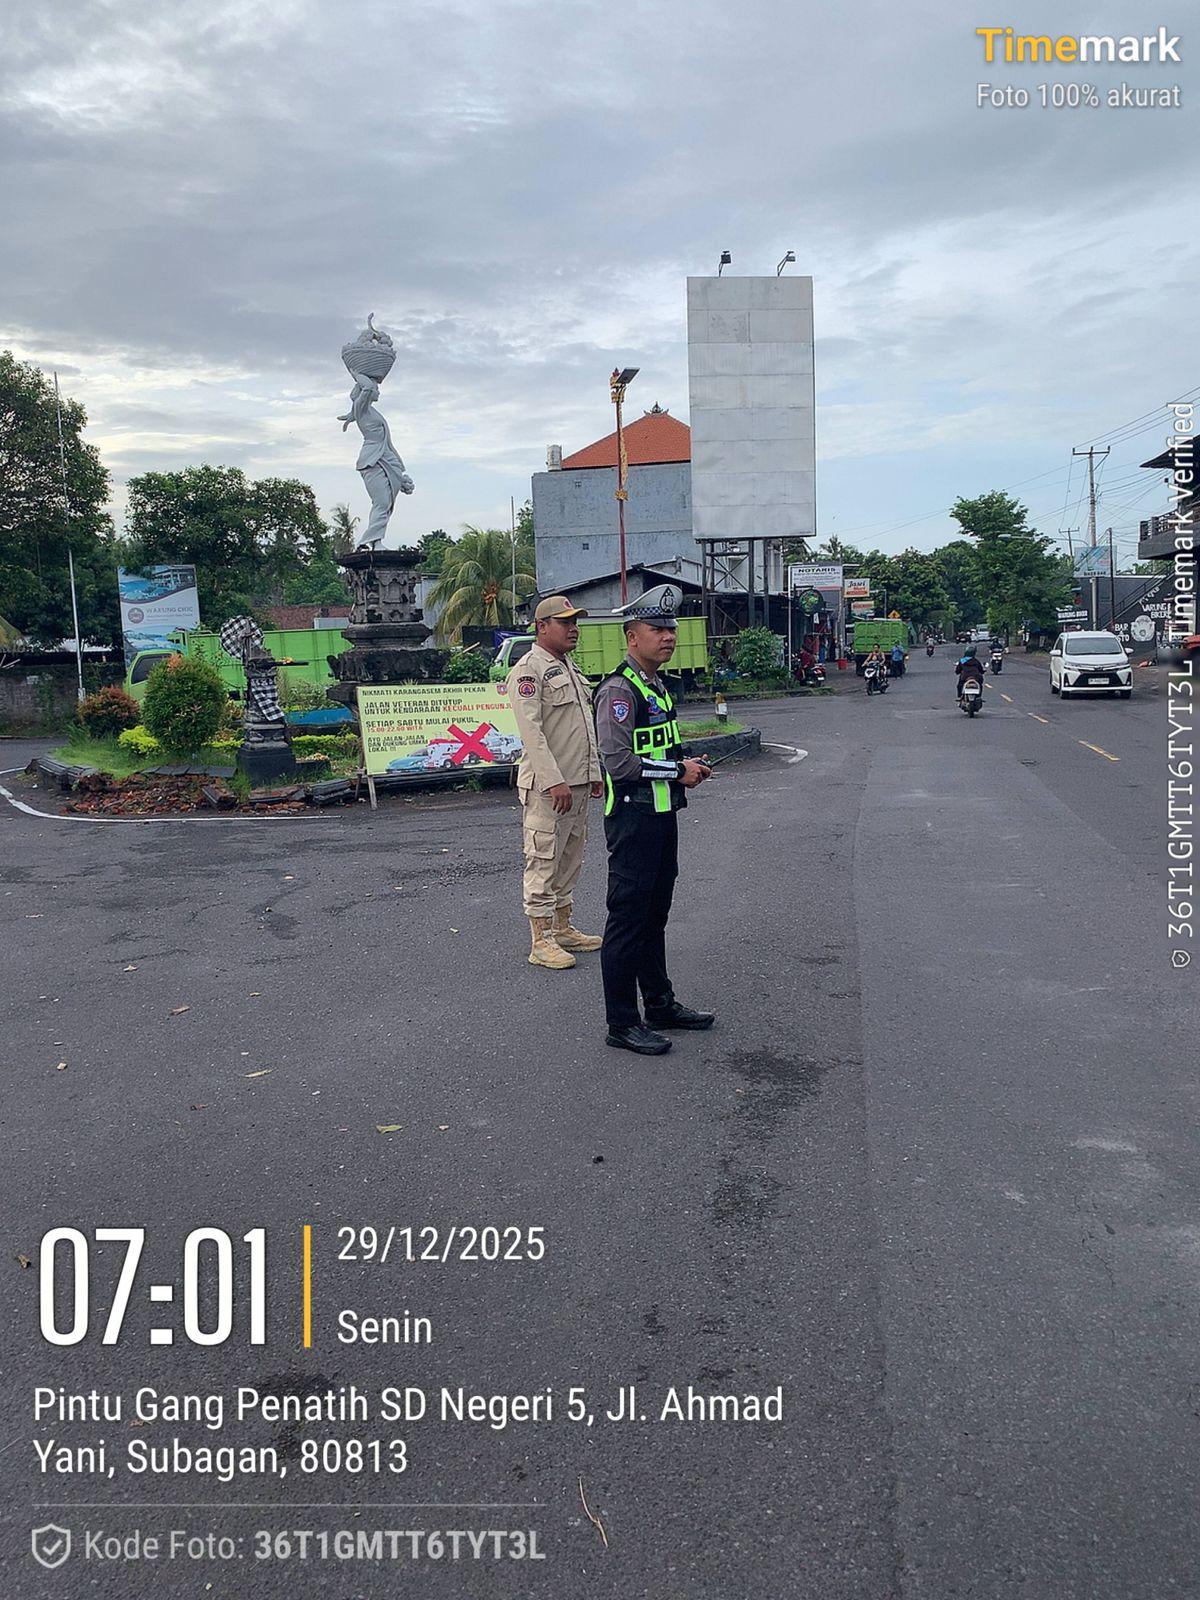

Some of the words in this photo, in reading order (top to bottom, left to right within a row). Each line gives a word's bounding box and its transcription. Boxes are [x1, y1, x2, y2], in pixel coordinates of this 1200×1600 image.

[393, 687, 442, 695] KARANGASEM
[364, 701, 390, 709] JALAN
[392, 700, 429, 708] VETERAN
[430, 698, 463, 706] DITUTUP
[393, 706, 441, 714] KENDARAAN
[442, 704, 474, 712] KECUALI
[365, 720, 395, 728] SETIAP
[397, 719, 424, 727] SABTU
